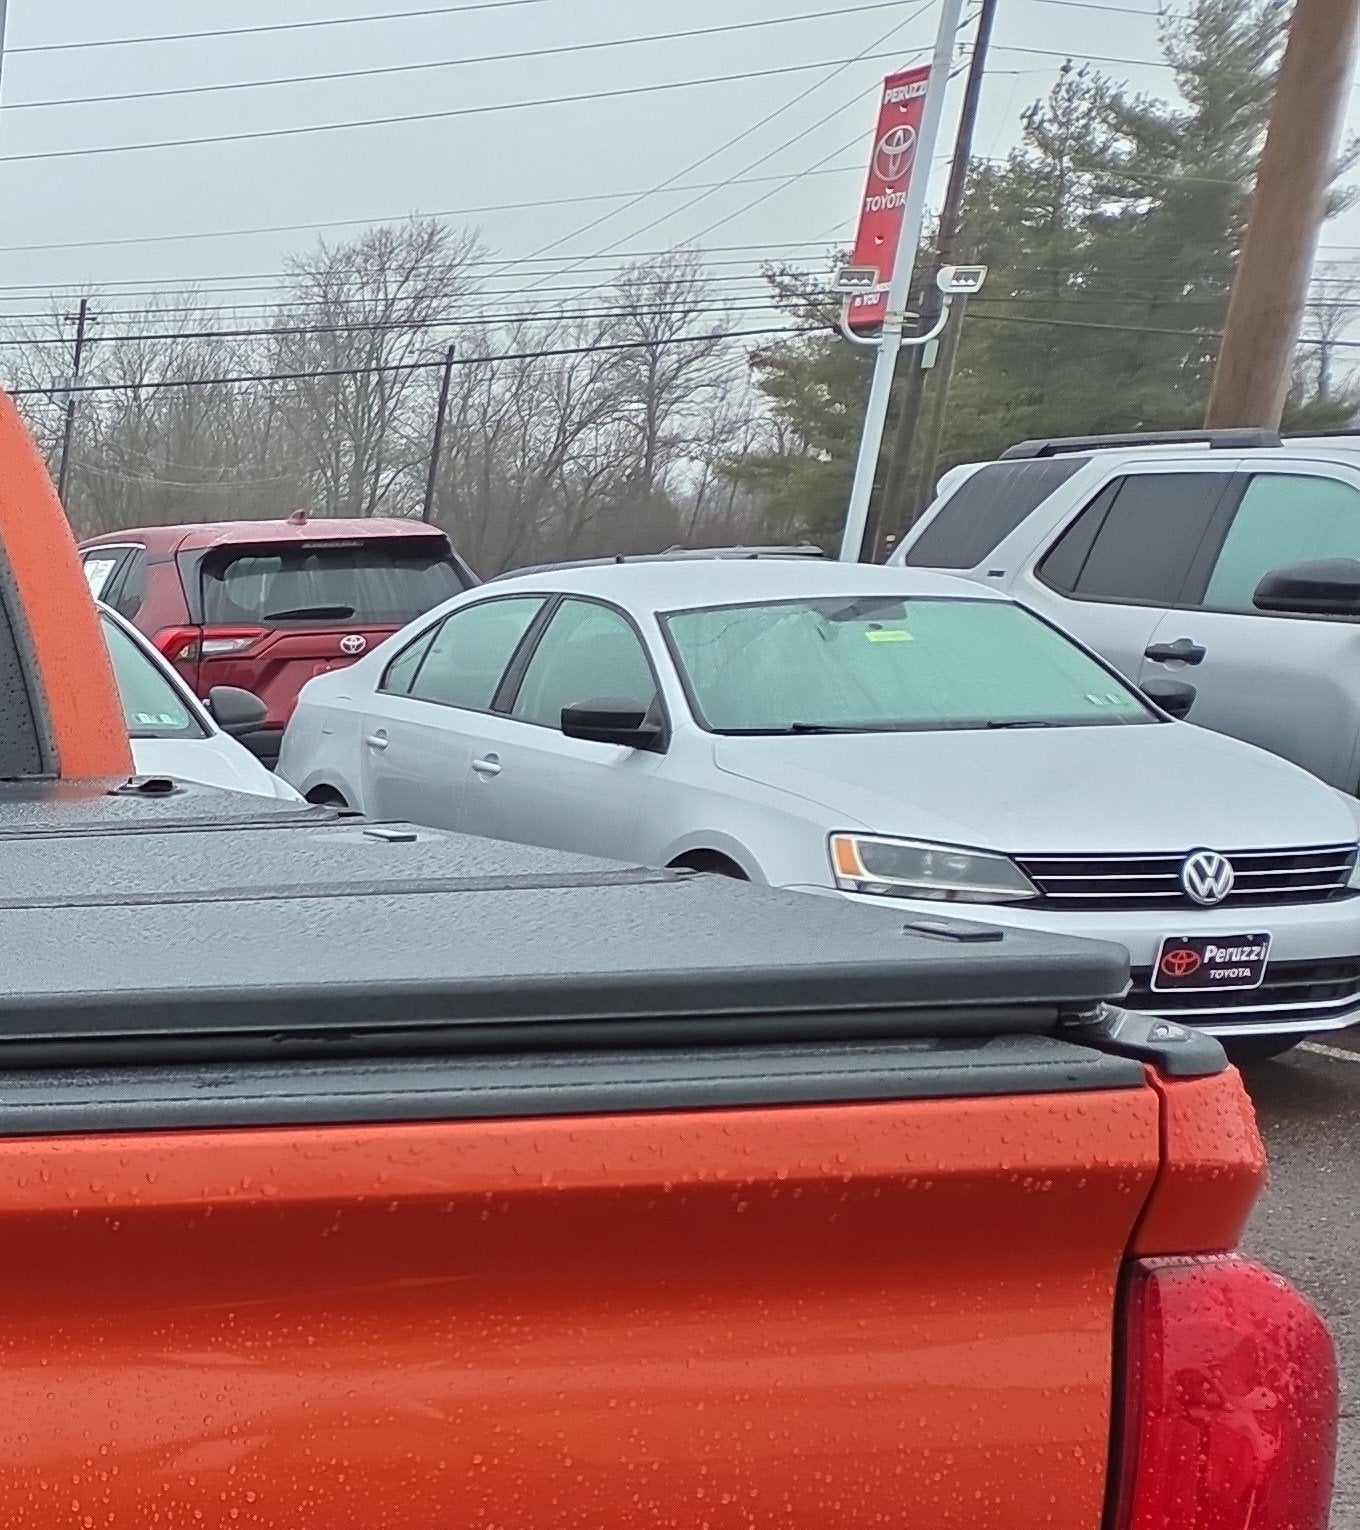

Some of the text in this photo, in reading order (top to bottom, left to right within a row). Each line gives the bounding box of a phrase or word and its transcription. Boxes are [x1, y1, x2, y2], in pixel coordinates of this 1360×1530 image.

[865, 190, 907, 213] TOYOTA
[1203, 942, 1268, 964] Peruzzi
[1209, 967, 1252, 979] TOYOTA
